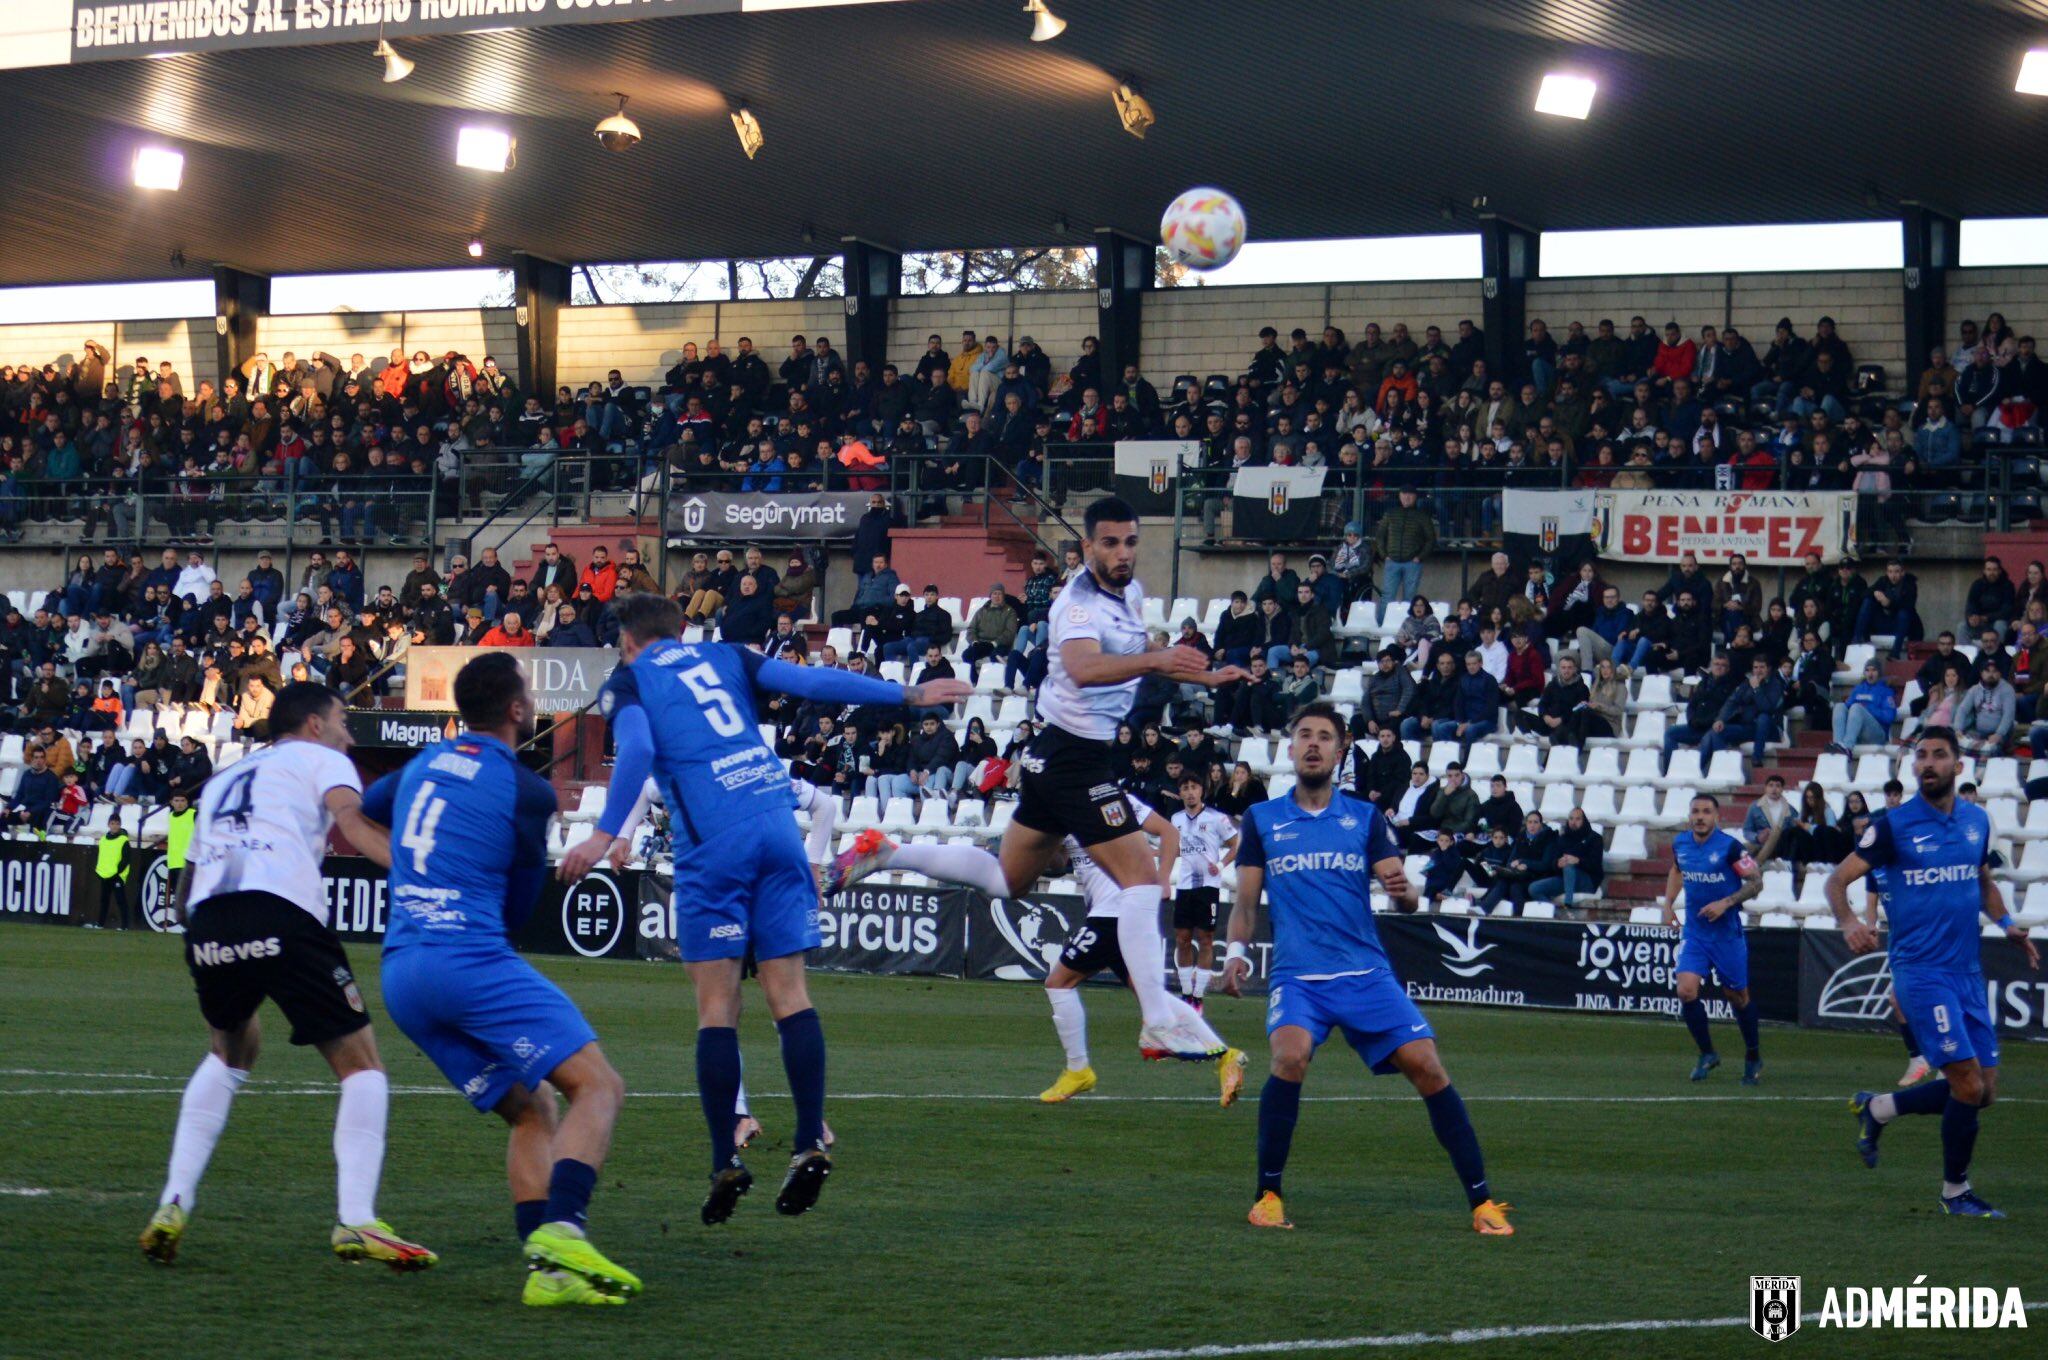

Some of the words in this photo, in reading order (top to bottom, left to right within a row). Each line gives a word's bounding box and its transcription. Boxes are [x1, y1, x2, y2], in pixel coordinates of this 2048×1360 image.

[76, 0, 248, 47] BIENVENIDOS
[253, 0, 288, 33] AL
[296, 0, 412, 29] ESTADIO
[1642, 493, 1700, 507] PEÑA
[1714, 494, 1811, 508] ROMANA
[1623, 495, 1823, 557] BENÍTEZ
[518, 659, 589, 692] IDA
[677, 662, 745, 737] 5
[381, 721, 441, 746] Magna
[211, 766, 258, 831] 4
[401, 780, 447, 875] 4
[1266, 852, 1365, 876] TECNITASA
[0, 854, 72, 915] CIÓN
[322, 877, 387, 933] FEDE
[577, 893, 609, 911] RF
[577, 918, 608, 936] EF
[1072, 926, 1097, 954] 12
[193, 937, 281, 967] Nieves
[1406, 981, 1524, 1005] Extremadura
[1575, 993, 1610, 1009] JUNTA
[1618, 995, 1635, 1010] DE
[1640, 996, 1734, 1019] EXTREDURA
[1933, 1004, 1951, 1033] 9
